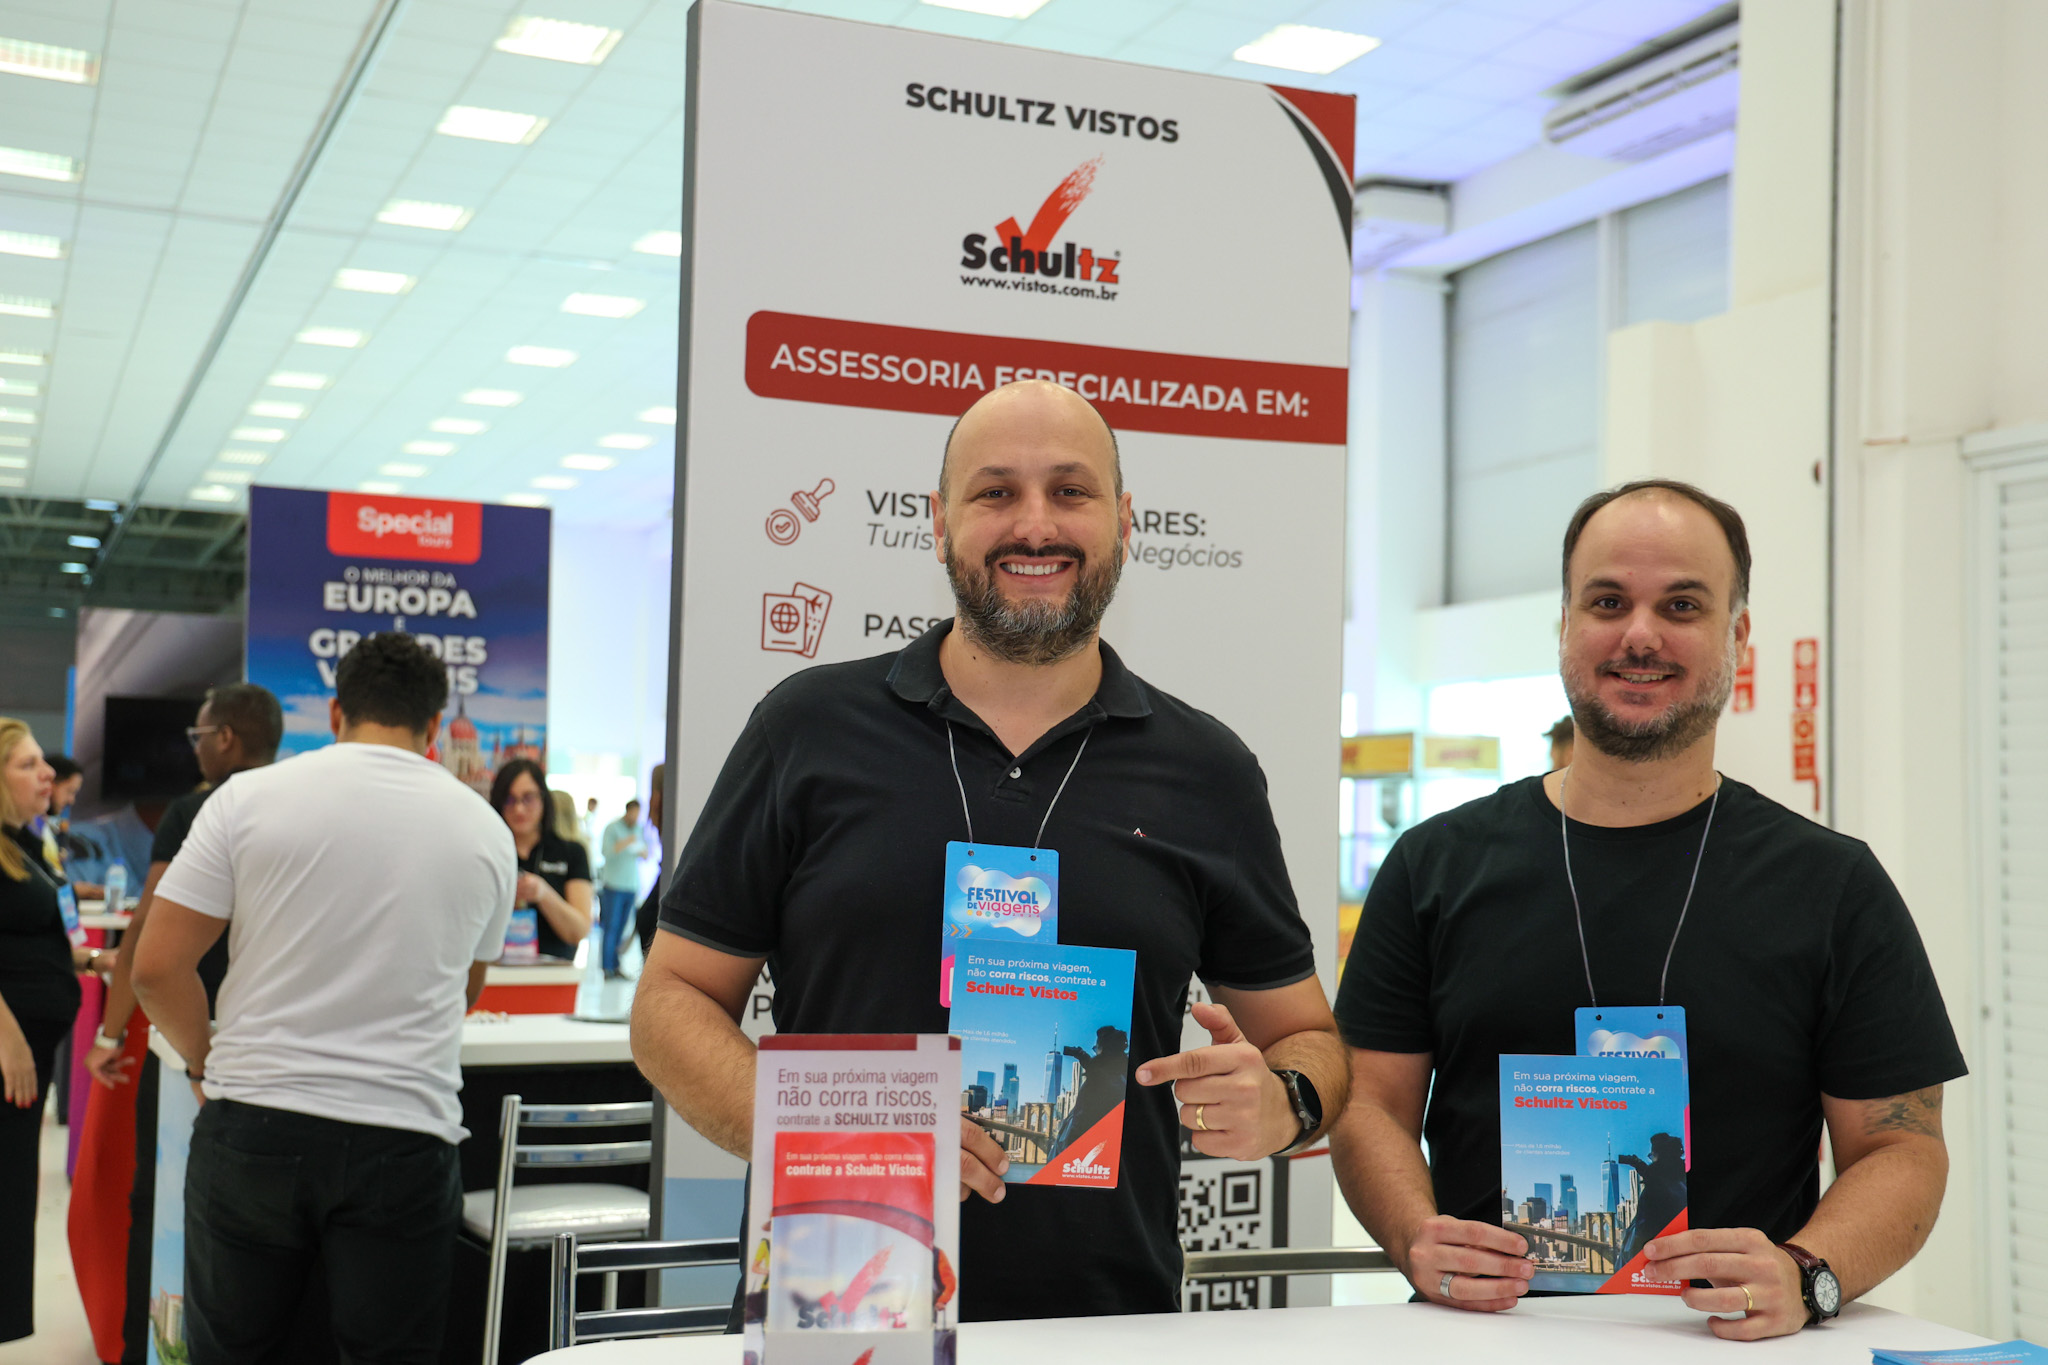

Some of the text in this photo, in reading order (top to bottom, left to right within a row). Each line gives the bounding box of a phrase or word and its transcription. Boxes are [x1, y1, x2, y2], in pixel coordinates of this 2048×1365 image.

[906, 83, 1179, 143] SCHULTZ VISTOS
[961, 233, 1120, 284] Schultz
[960, 275, 1118, 301] www.vistos.com.br
[770, 343, 986, 391] ASSESSORIA
[1255, 389, 1310, 418] EM:
[357, 506, 454, 538] Special
[1129, 541, 1243, 571] Negócios
[344, 566, 457, 588] O MELHOR DA
[323, 581, 478, 618] EUROPA
[309, 628, 488, 665] GRDES
[967, 886, 1038, 904] FESTIVAL
[967, 900, 1040, 916] DE viagens
[968, 955, 1092, 974] Em sua próxima viagem,
[967, 967, 1107, 987] não corra riscos, contrate a
[966, 980, 1078, 1001] Schultz Vistos
[778, 1068, 938, 1087] Em sua próxima viagem
[1513, 1071, 1640, 1083] Em sua próxima viagem,
[777, 1086, 937, 1110] não corra riscos,
[1514, 1083, 1655, 1095] não corra riscos, contrate a
[1514, 1096, 1628, 1110] Schultz Vistos
[777, 1112, 937, 1126] contrate a SCHULTZ VISTOS
[786, 1152, 799, 1160] Em
[785, 1163, 927, 1176] contrate a Schultz Vistos.
[1062, 1162, 1111, 1174] Schultz
